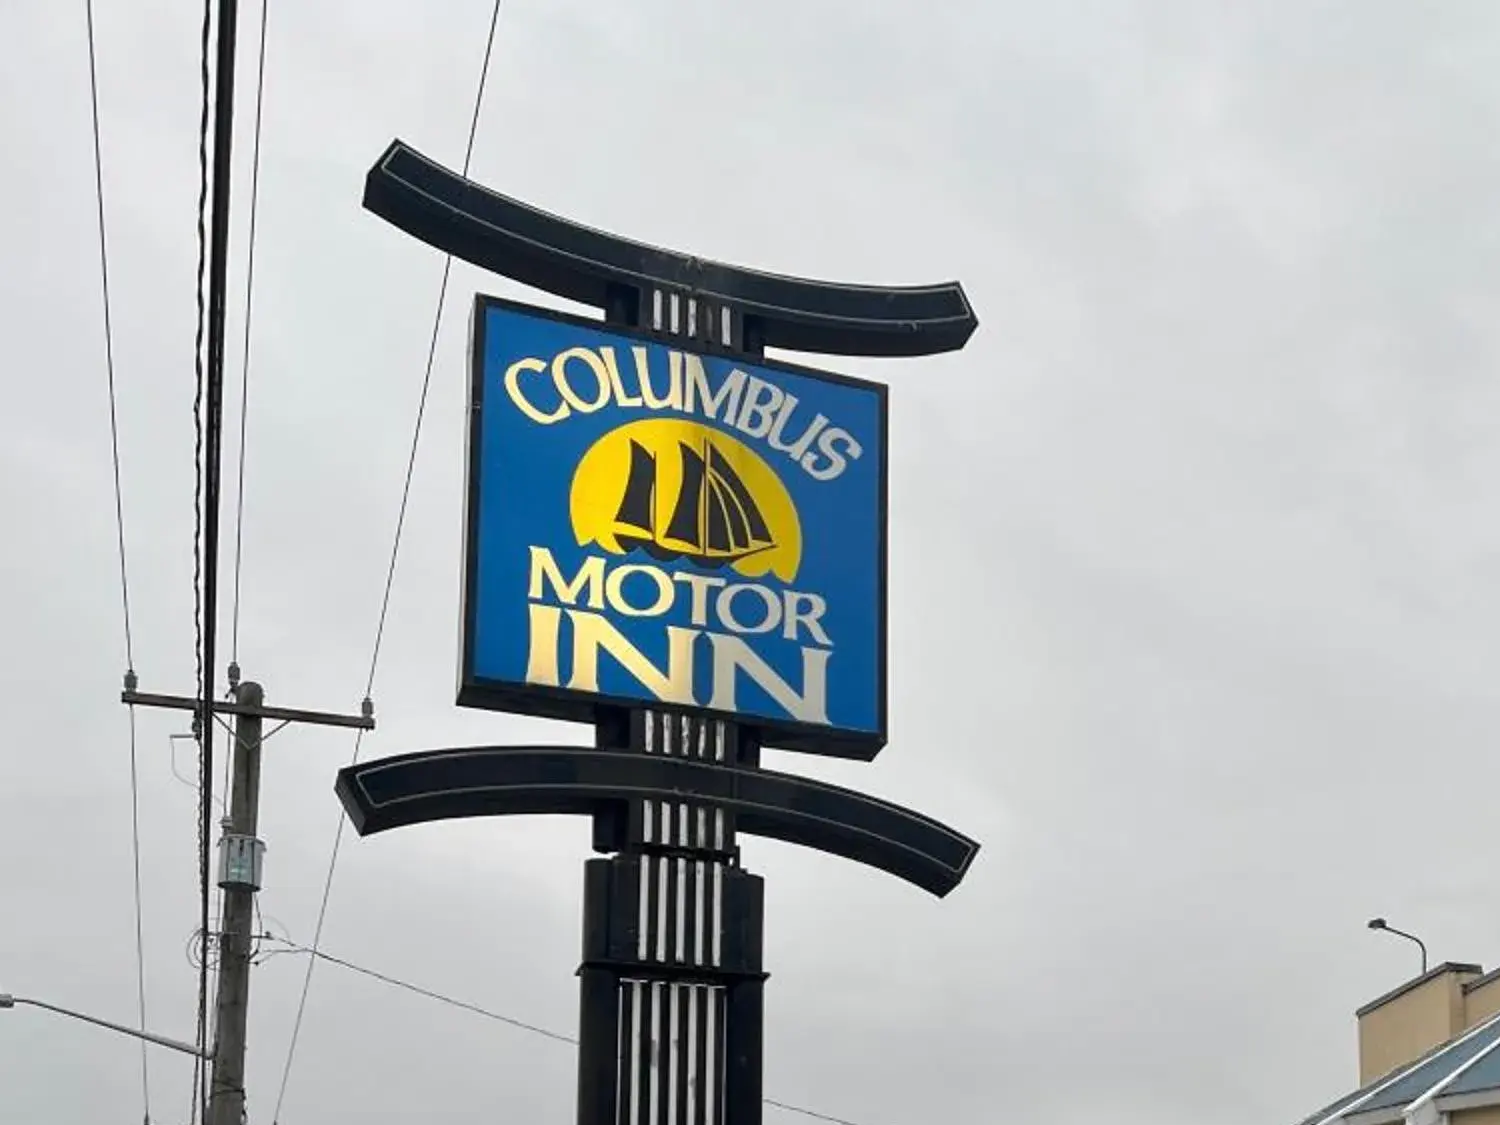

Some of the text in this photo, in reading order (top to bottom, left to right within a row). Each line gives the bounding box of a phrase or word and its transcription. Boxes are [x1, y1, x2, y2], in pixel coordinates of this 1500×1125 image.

[504, 346, 863, 481] COLUMBUS
[527, 545, 834, 647] MOTOR
[525, 602, 834, 726] INN
